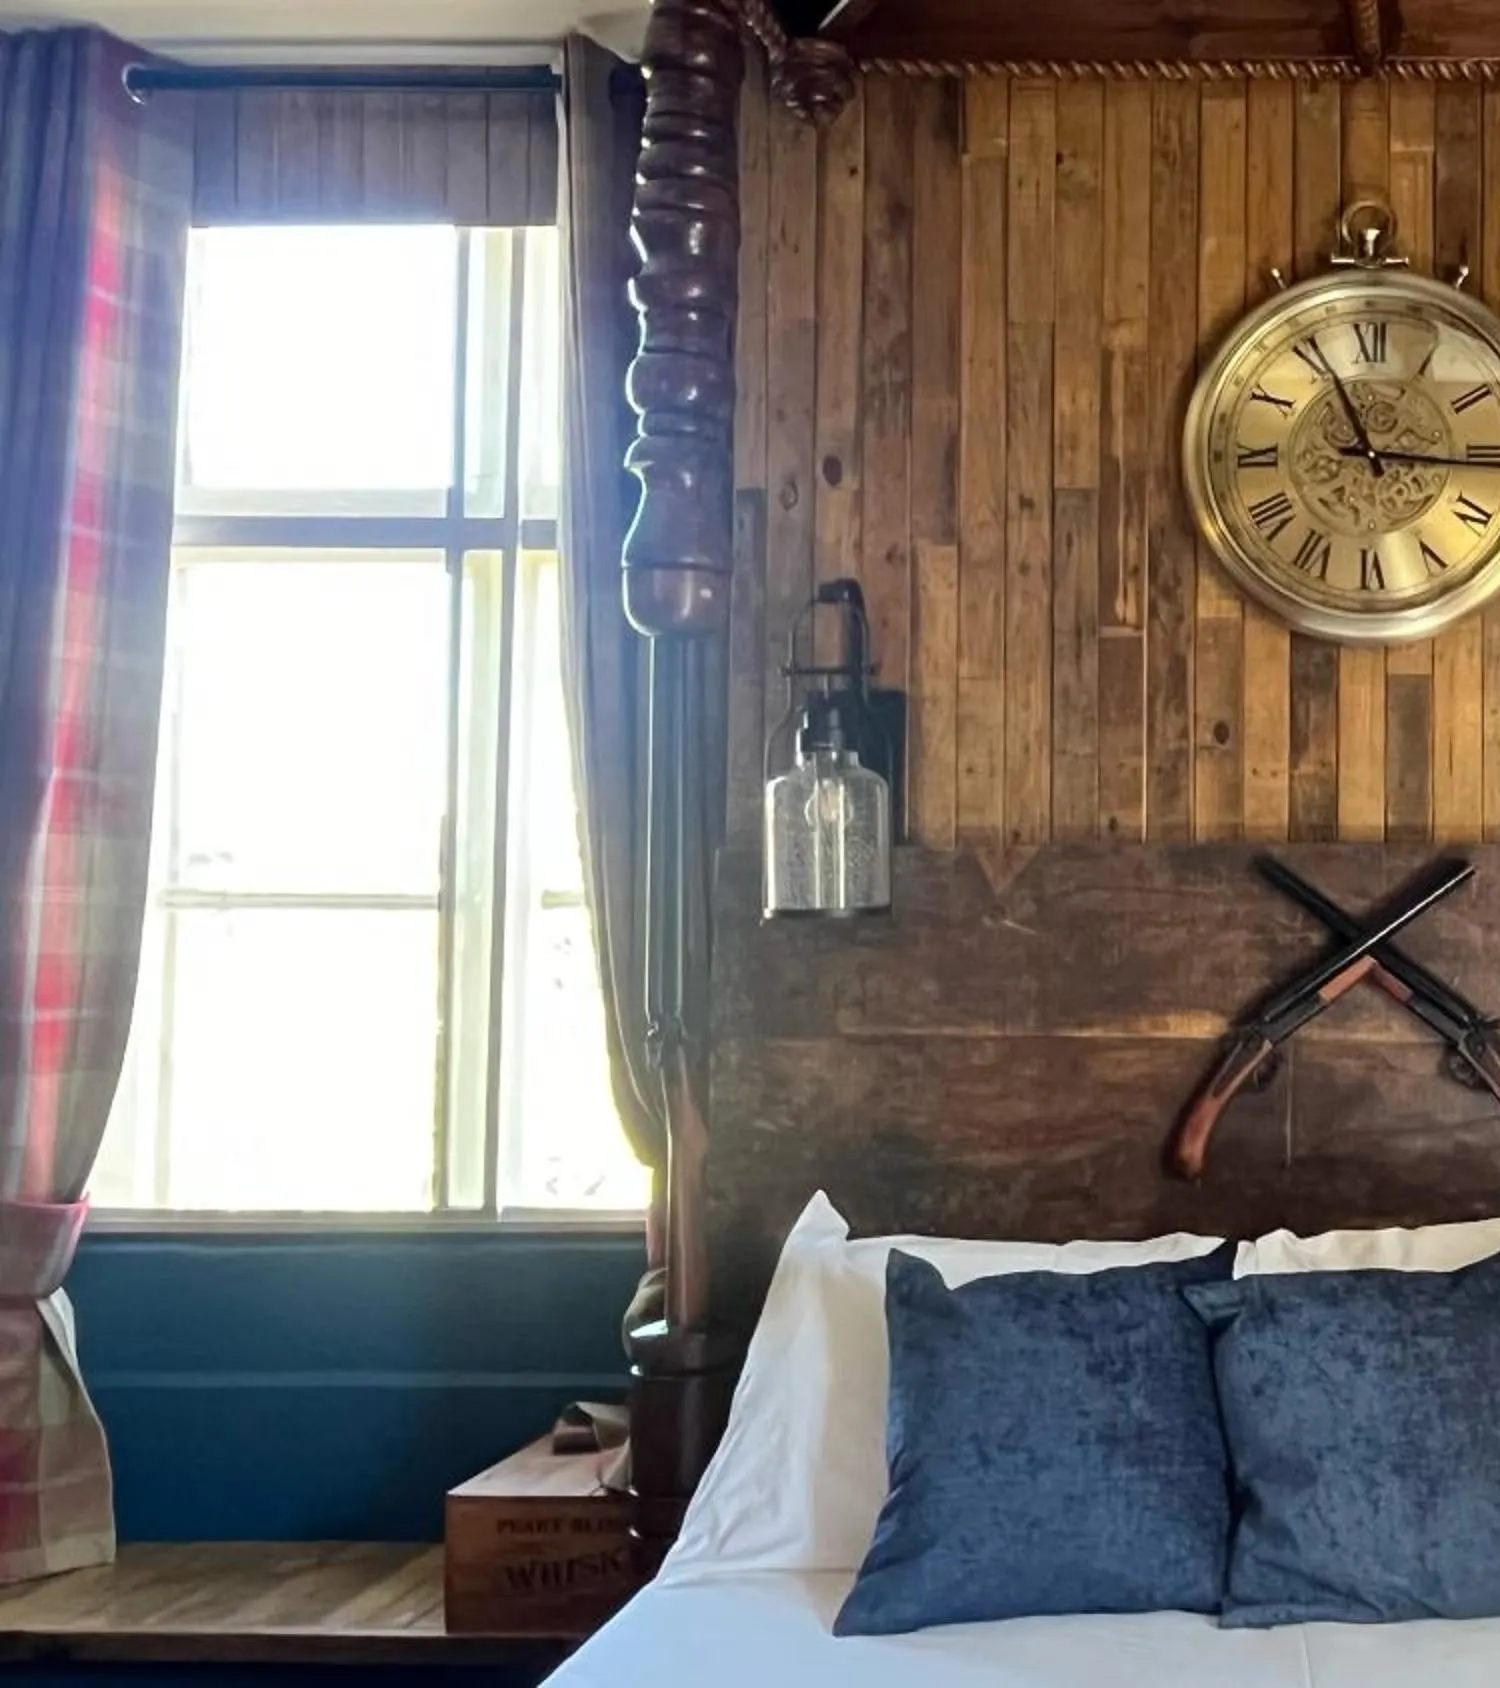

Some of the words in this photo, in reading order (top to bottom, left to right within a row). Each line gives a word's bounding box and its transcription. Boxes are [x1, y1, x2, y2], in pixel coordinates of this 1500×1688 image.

[1352, 321, 1388, 364] XII
[1249, 382, 1297, 420] X
[1451, 382, 1493, 415] II
[1237, 442, 1279, 469] IX
[1248, 491, 1297, 542] VIII
[1451, 490, 1494, 537] IV
[1293, 527, 1332, 582] VII
[1360, 548, 1386, 590] VI
[1417, 535, 1449, 576] V
